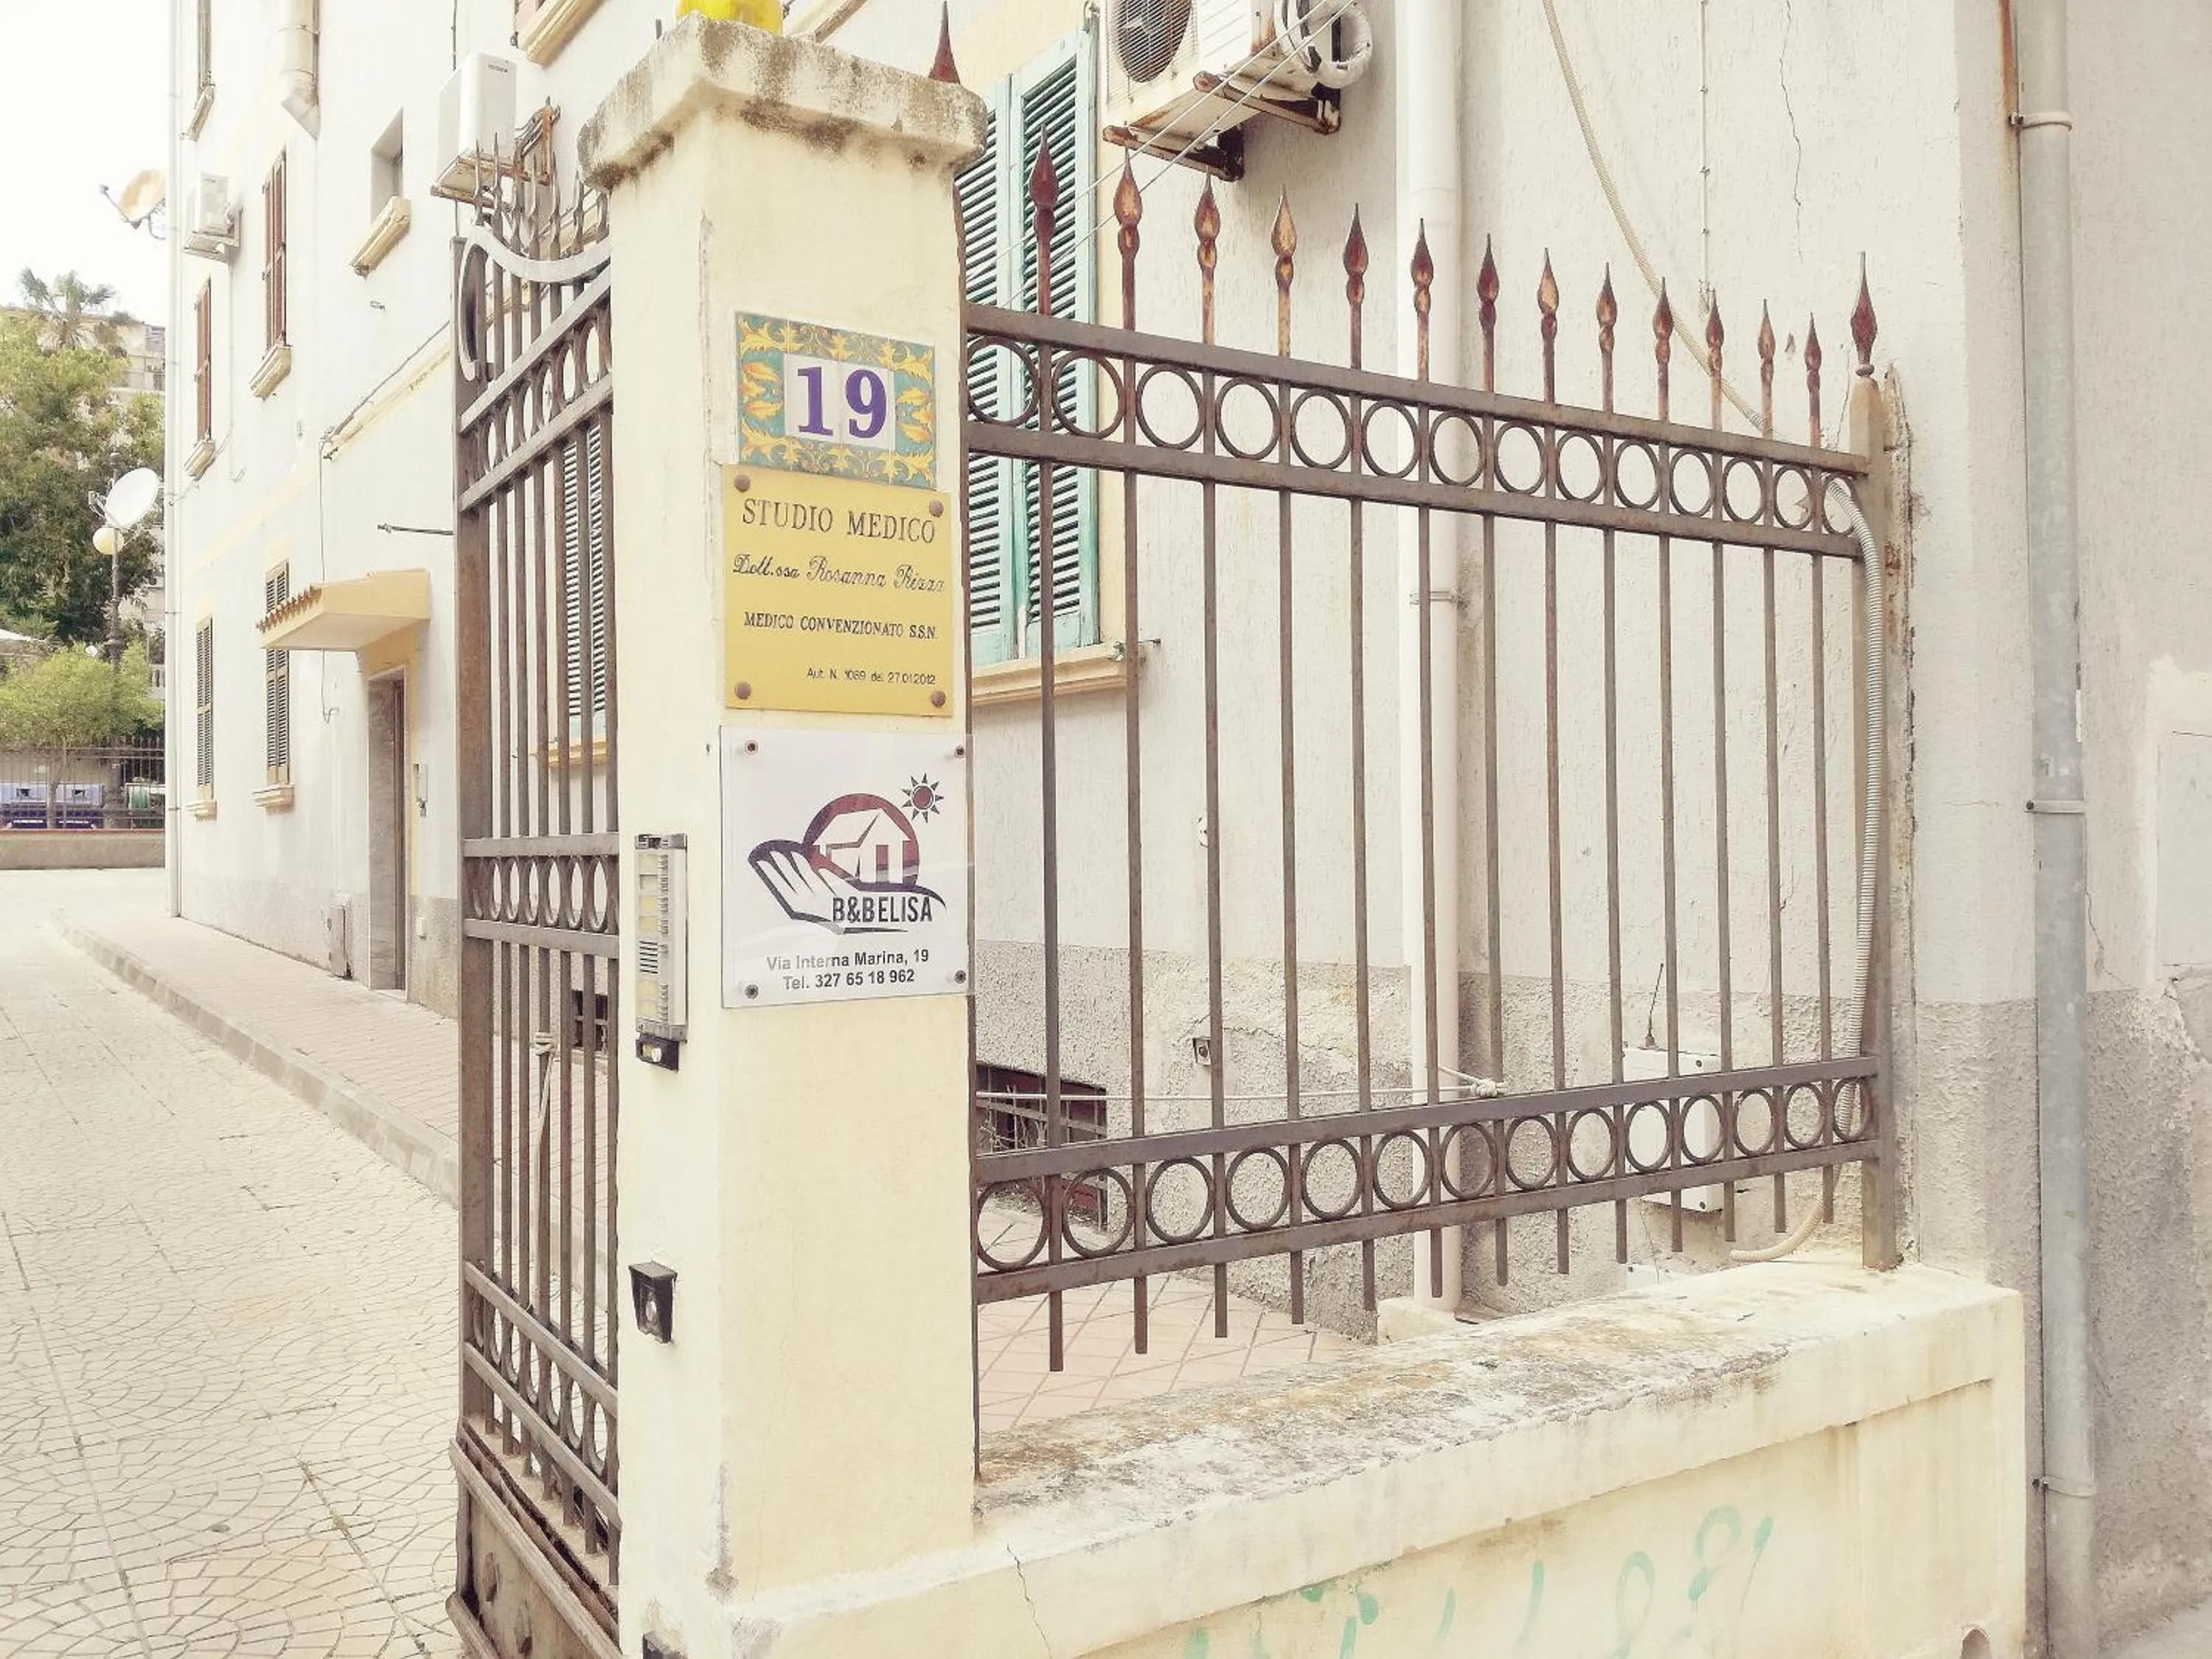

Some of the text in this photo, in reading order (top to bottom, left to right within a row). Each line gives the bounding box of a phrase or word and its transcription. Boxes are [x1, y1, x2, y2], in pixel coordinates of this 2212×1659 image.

[797, 366, 887, 439] 19
[742, 498, 935, 543] STUDIO MEDICO
[806, 555, 886, 588] Rosanna
[744, 611, 794, 629] MEDICO
[799, 616, 904, 637] CONVENZIONATO
[766, 949, 929, 971] Via Interna Marina, 19
[783, 969, 914, 990] Tel. 327 65 18 962
